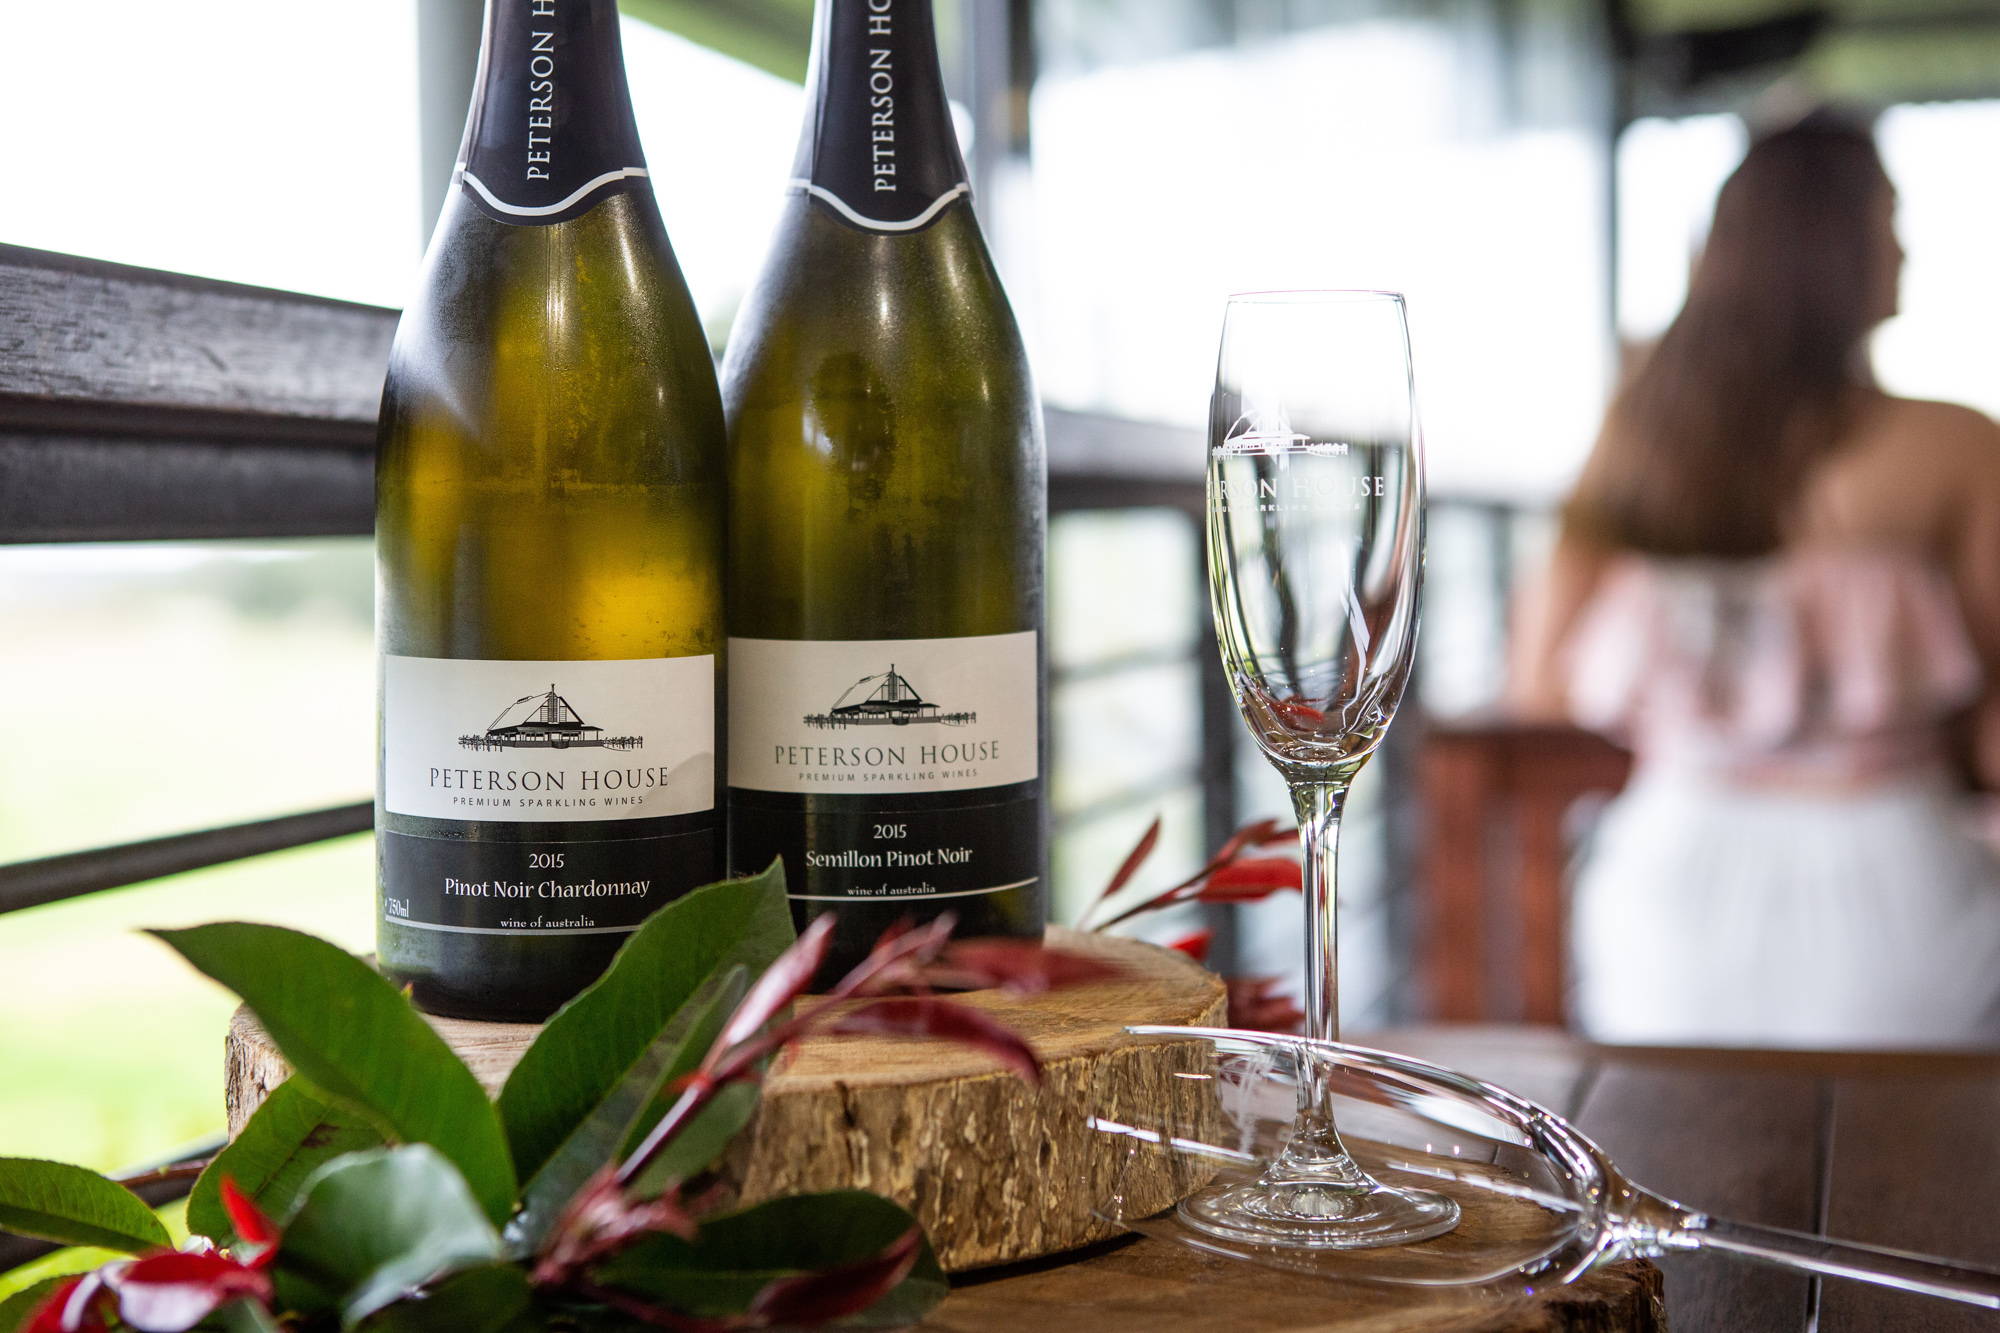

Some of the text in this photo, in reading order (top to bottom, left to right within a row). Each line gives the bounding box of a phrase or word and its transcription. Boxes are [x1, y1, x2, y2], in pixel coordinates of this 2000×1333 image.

[526, 31, 554, 180] PETERSON
[869, 49, 897, 192] PETERSON
[774, 740, 1000, 766] PETERSON HOUSE
[430, 767, 668, 792] PETERSON HOUSE
[798, 768, 977, 782] PREMIUM SPARKLING WINES
[453, 795, 643, 808] PREMIUM SPARKLING WINES
[873, 824, 907, 839] 2015
[529, 853, 565, 869] 2015
[806, 848, 973, 868] Semillon Pinot Noir
[445, 877, 650, 898] Pinot Noir Chardonnay
[847, 881, 936, 896] wine of australia
[500, 914, 595, 928] wine of australia
